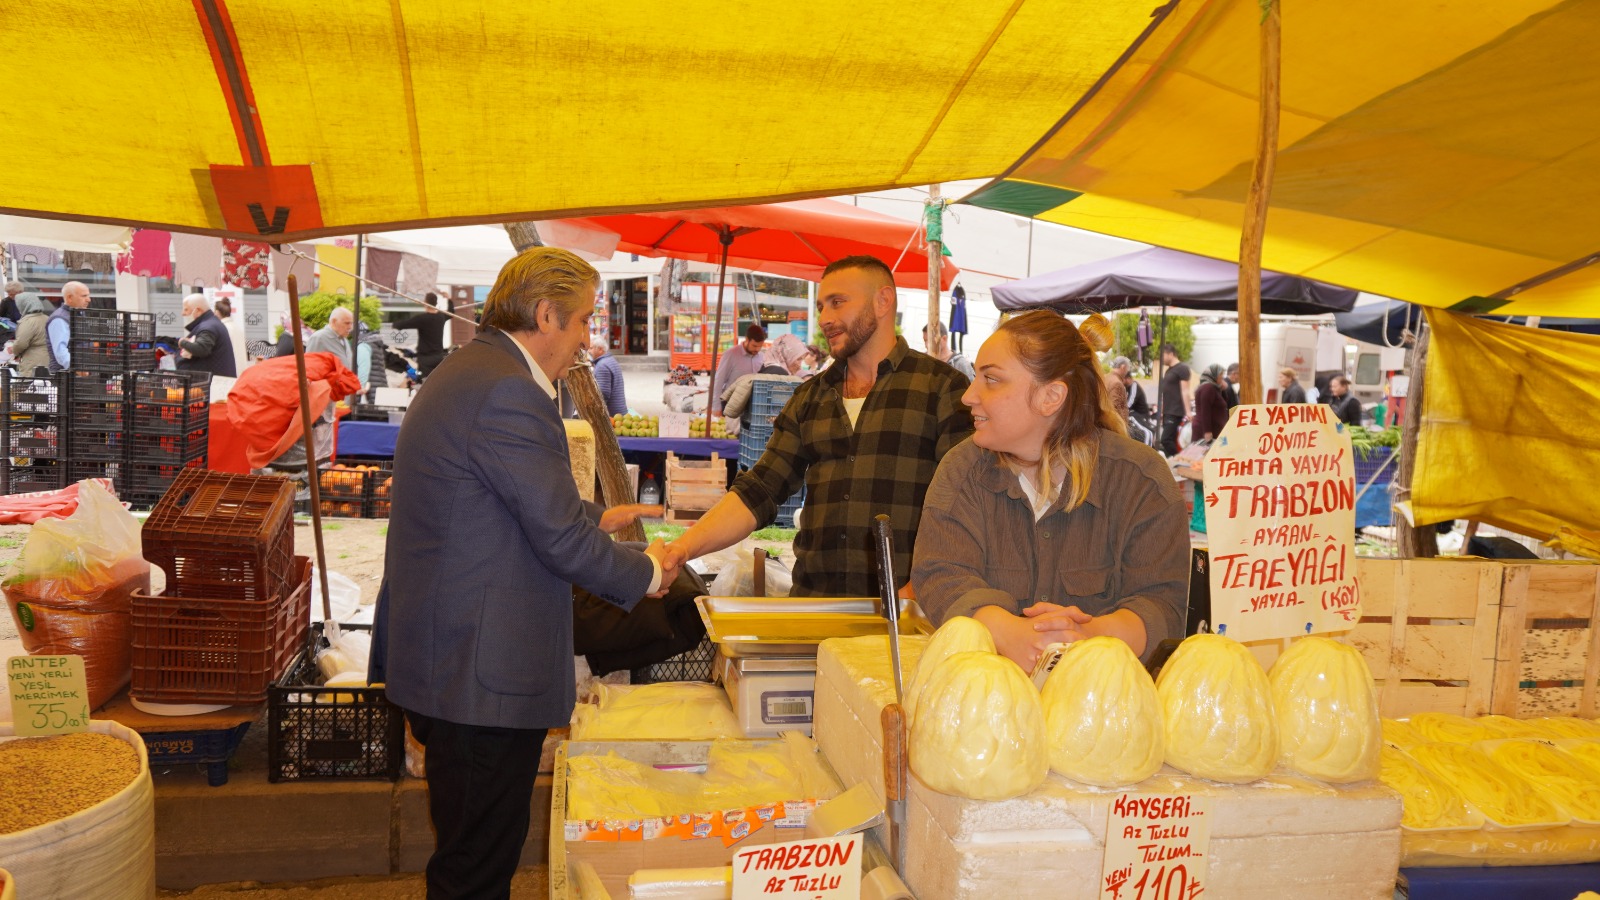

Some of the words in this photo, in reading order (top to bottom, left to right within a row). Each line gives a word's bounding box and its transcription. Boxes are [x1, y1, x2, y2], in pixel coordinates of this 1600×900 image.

[1237, 409, 1259, 427] EL
[1266, 406, 1327, 425] YAPIMI
[1259, 427, 1319, 455] DÖVME
[1211, 457, 1283, 477] TAHTA
[1291, 448, 1344, 477] YAYIK
[1218, 477, 1355, 518] TRABZON
[1214, 535, 1346, 590] TEREYAĞI
[8, 671, 35, 681] YENİ
[40, 668, 72, 678] YERLİ
[11, 657, 68, 670] ANTEP
[14, 691, 79, 701] MERCİMEK
[739, 841, 855, 873] TRABZON
